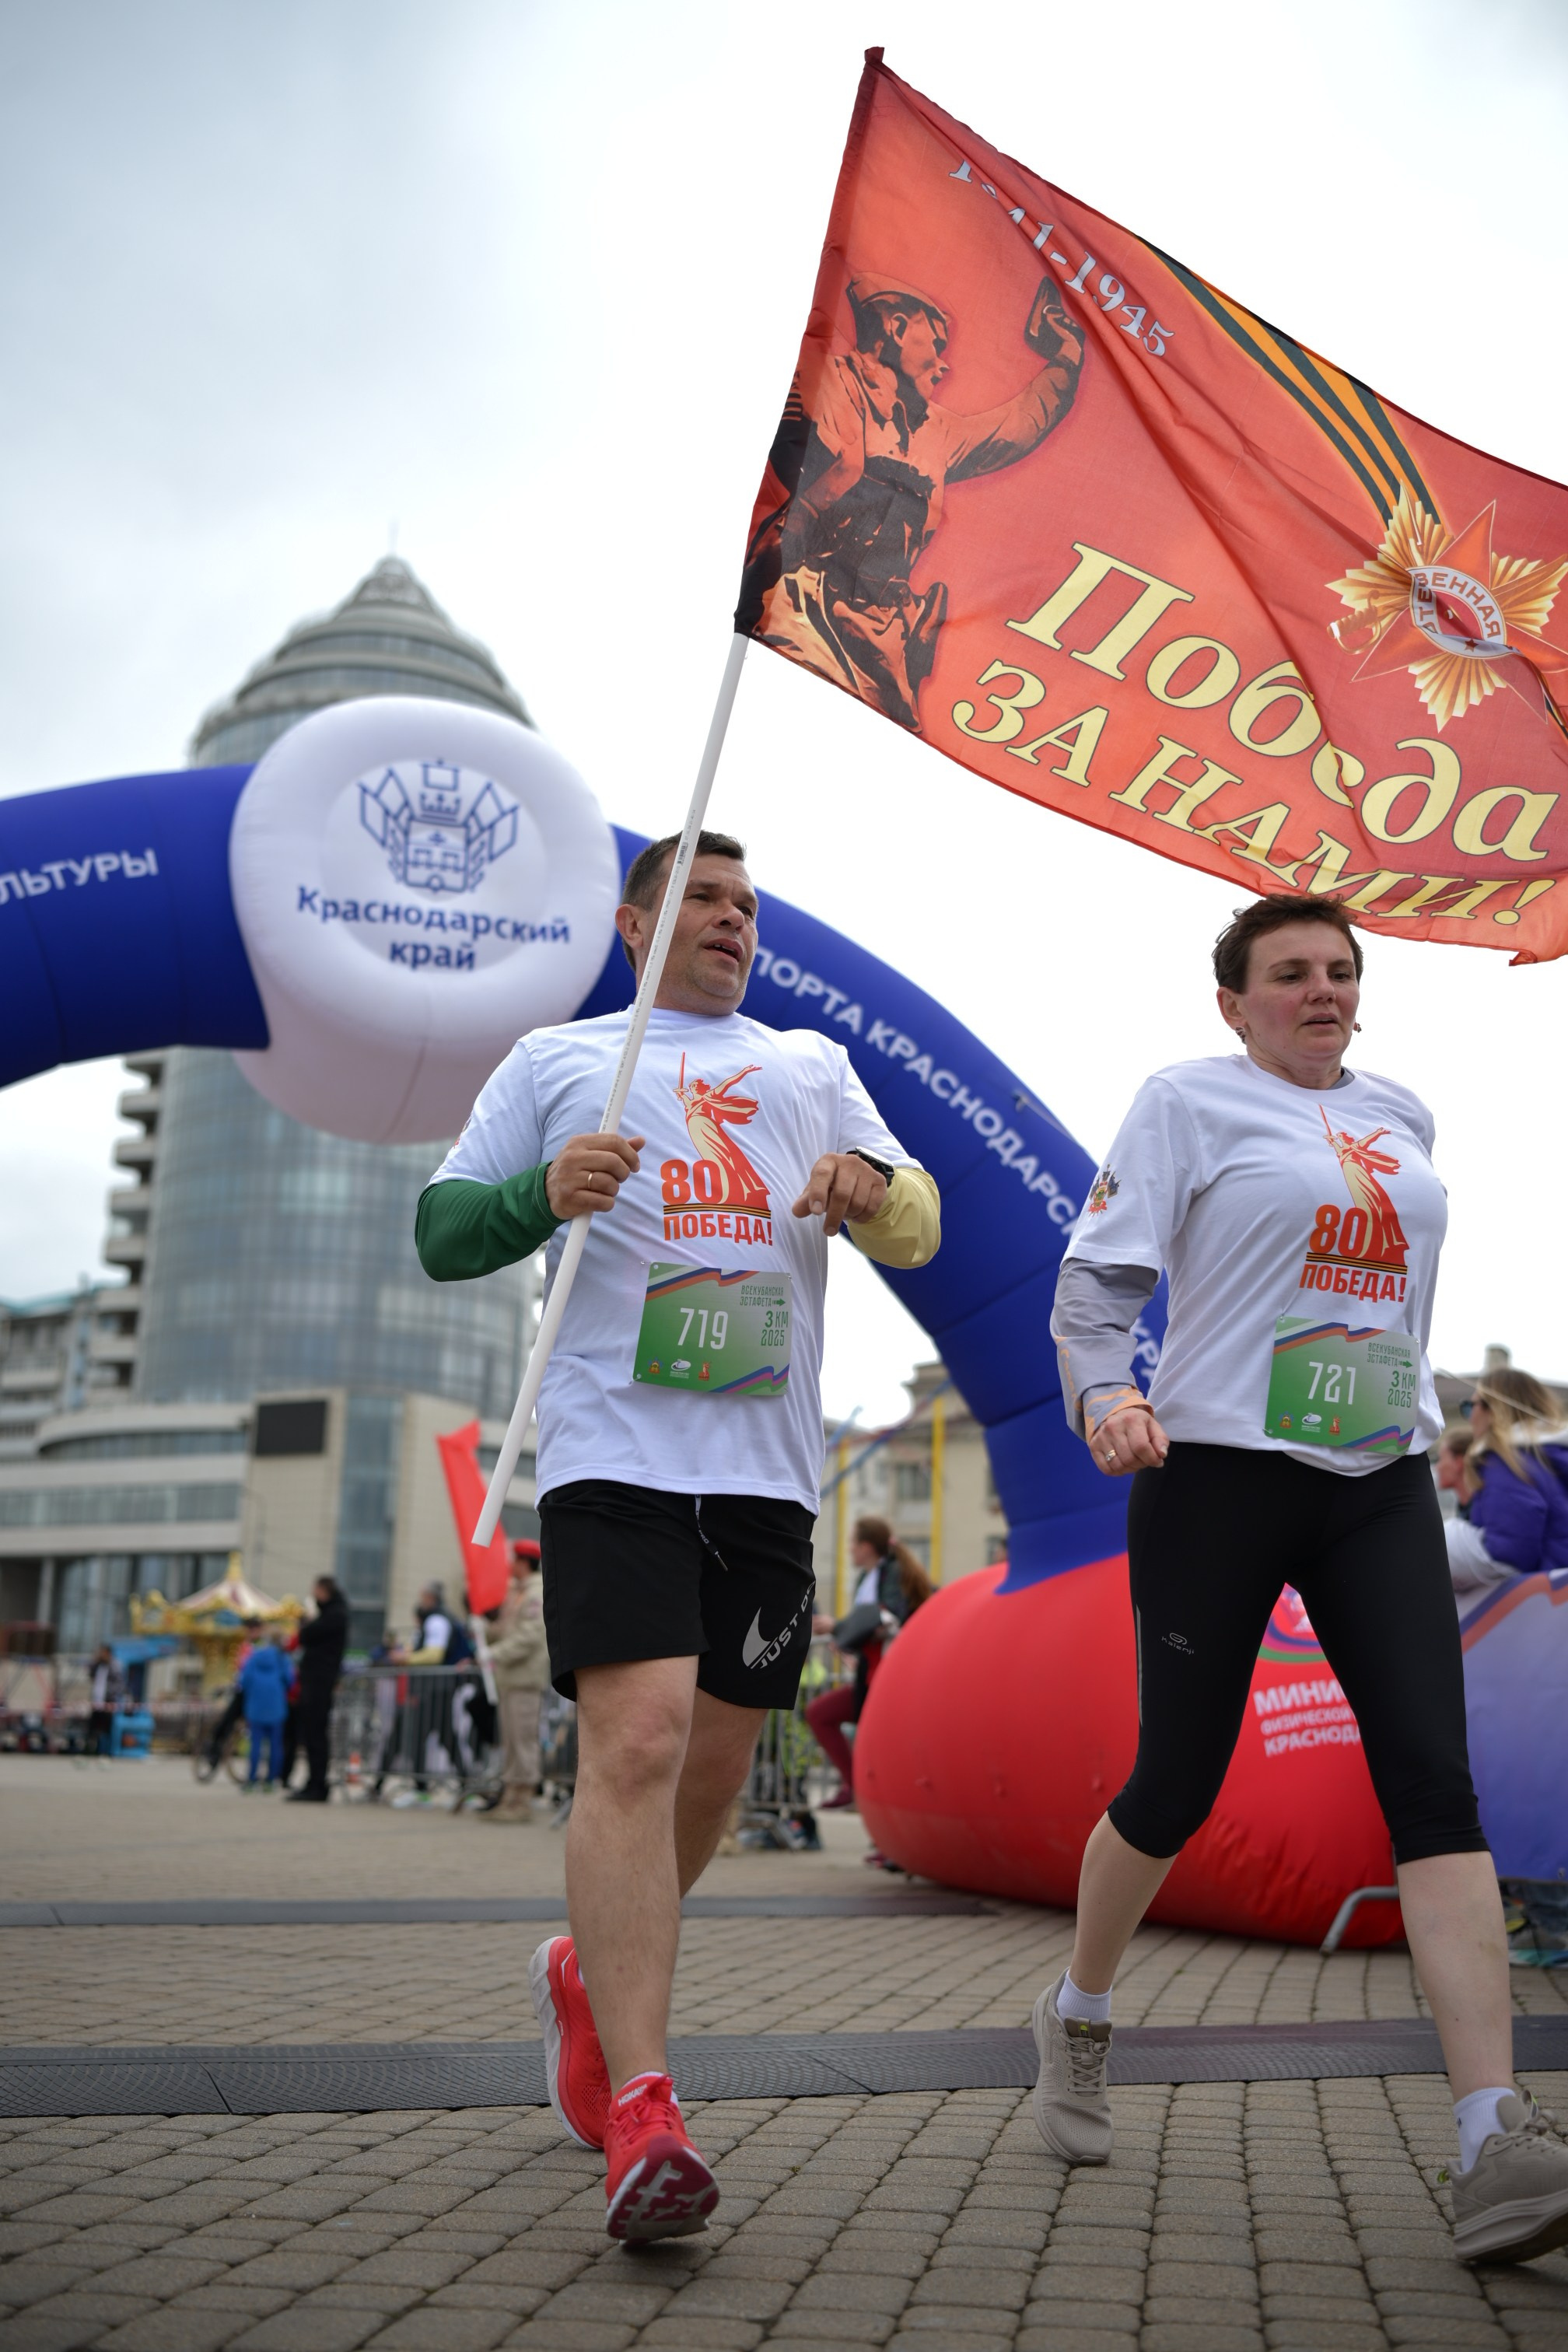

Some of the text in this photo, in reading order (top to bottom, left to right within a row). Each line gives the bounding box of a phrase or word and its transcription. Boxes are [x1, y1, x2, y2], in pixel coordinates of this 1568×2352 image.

[948, 159, 1176, 356] 11-1945
[1006, 541, 1560, 861] Победа
[951, 659, 1556, 926] ЗА НАМИ!
[297, 885, 571, 945] Краснодарский
[390, 941, 476, 971] край
[865, 1019, 1079, 1237] КРАСНОДАРС
[660, 1159, 724, 1205] 80
[663, 1213, 772, 1246] ПОБЕДА!
[1309, 1204, 1369, 1258] 80
[740, 1285, 784, 1297] ВСЕКУБАНСКАЯ
[740, 1296, 772, 1307] ЭСТАФЕТА
[1299, 1263, 1406, 1303] ПОБЕДА!
[677, 1307, 729, 1351] 719
[761, 1329, 785, 1346] 2025
[765, 1311, 789, 1328] 3 КМ
[1367, 1353, 1398, 1367] ЭСТАФЕТА
[1368, 1342, 1411, 1359] ВСЕКУБАНСКАЯ
[1307, 1361, 1357, 1405] 721
[1388, 1388, 1412, 1408] 2025
[1391, 1370, 1416, 1391] 3 КМ
[759, 1613, 798, 1668] JUST
[1253, 1678, 1347, 1717] МИНИ
